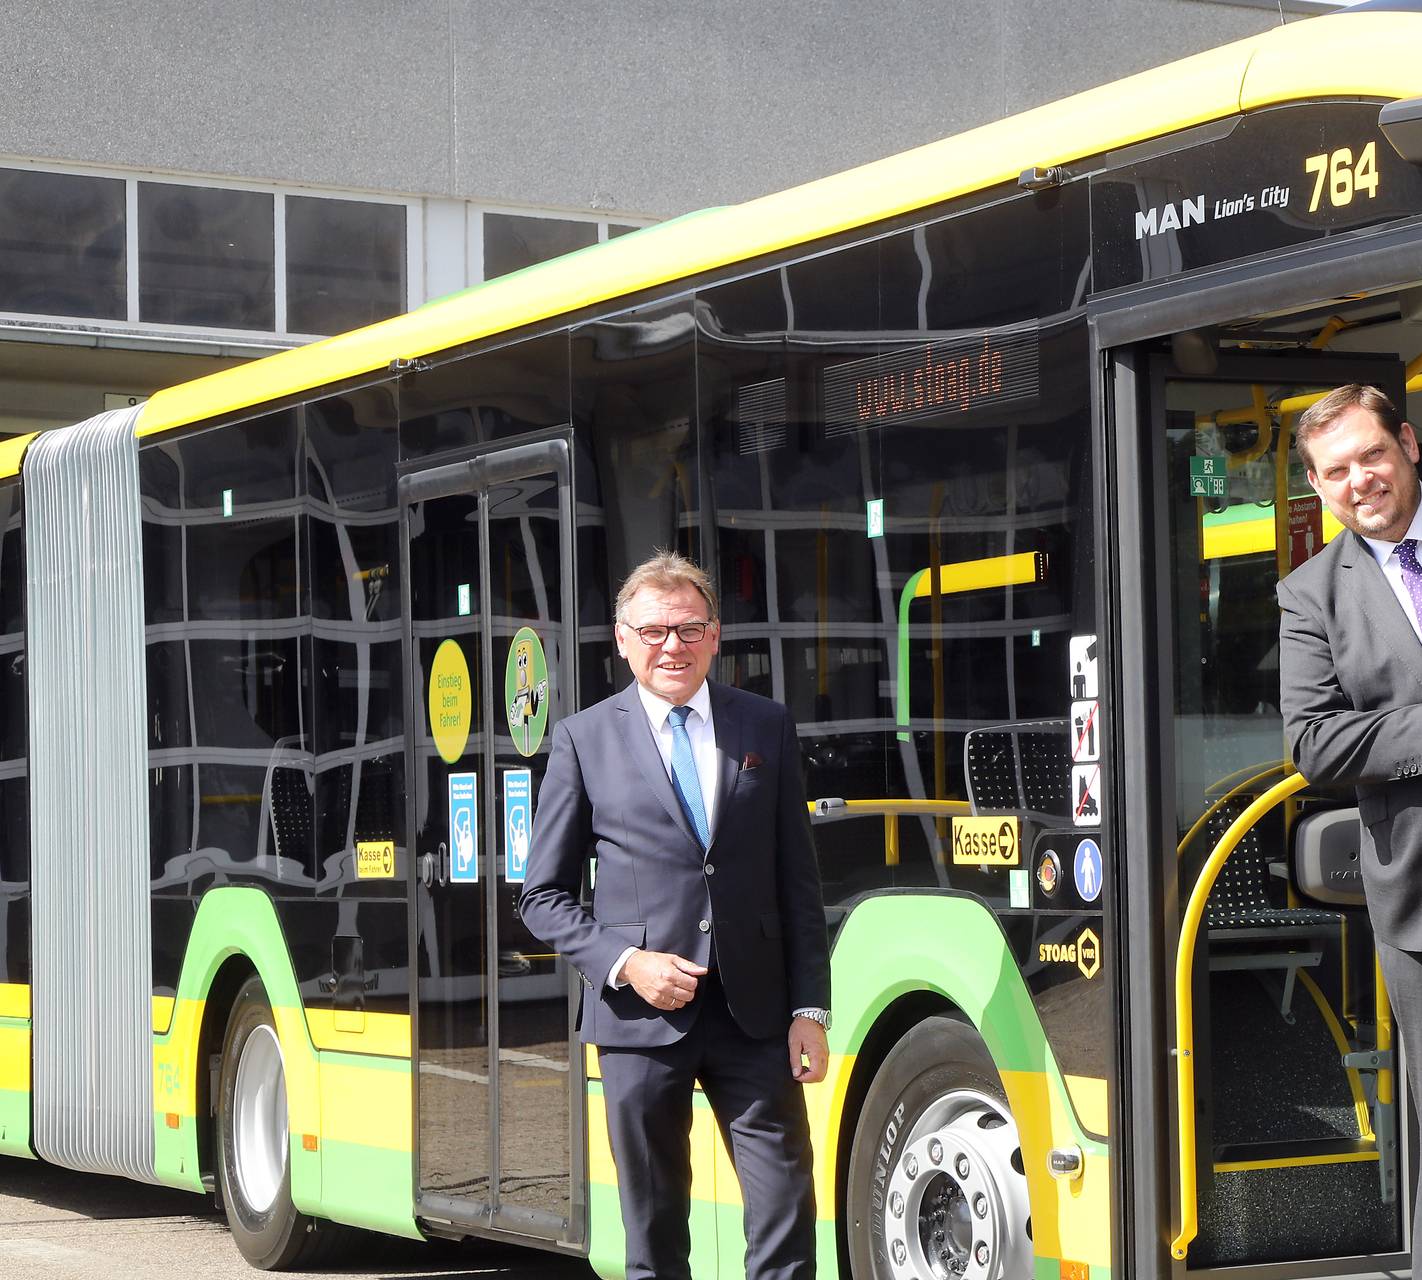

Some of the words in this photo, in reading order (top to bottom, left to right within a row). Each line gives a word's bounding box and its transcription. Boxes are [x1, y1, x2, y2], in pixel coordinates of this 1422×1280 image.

[1305, 141, 1379, 213] 764
[1135, 194, 1205, 240] MAN
[1214, 193, 1255, 220] Lion's
[1261, 185, 1290, 208] City
[856, 329, 1003, 420] www.stoag.de
[437, 673, 462, 691] Einstieg
[442, 693, 458, 708] beim
[440, 711, 462, 728] Fahrer!
[954, 824, 997, 856] Kasse
[358, 848, 381, 861] Kasse
[1039, 943, 1077, 962] STOAG
[1082, 948, 1095, 959] VRR
[158, 1062, 181, 1095] 764
